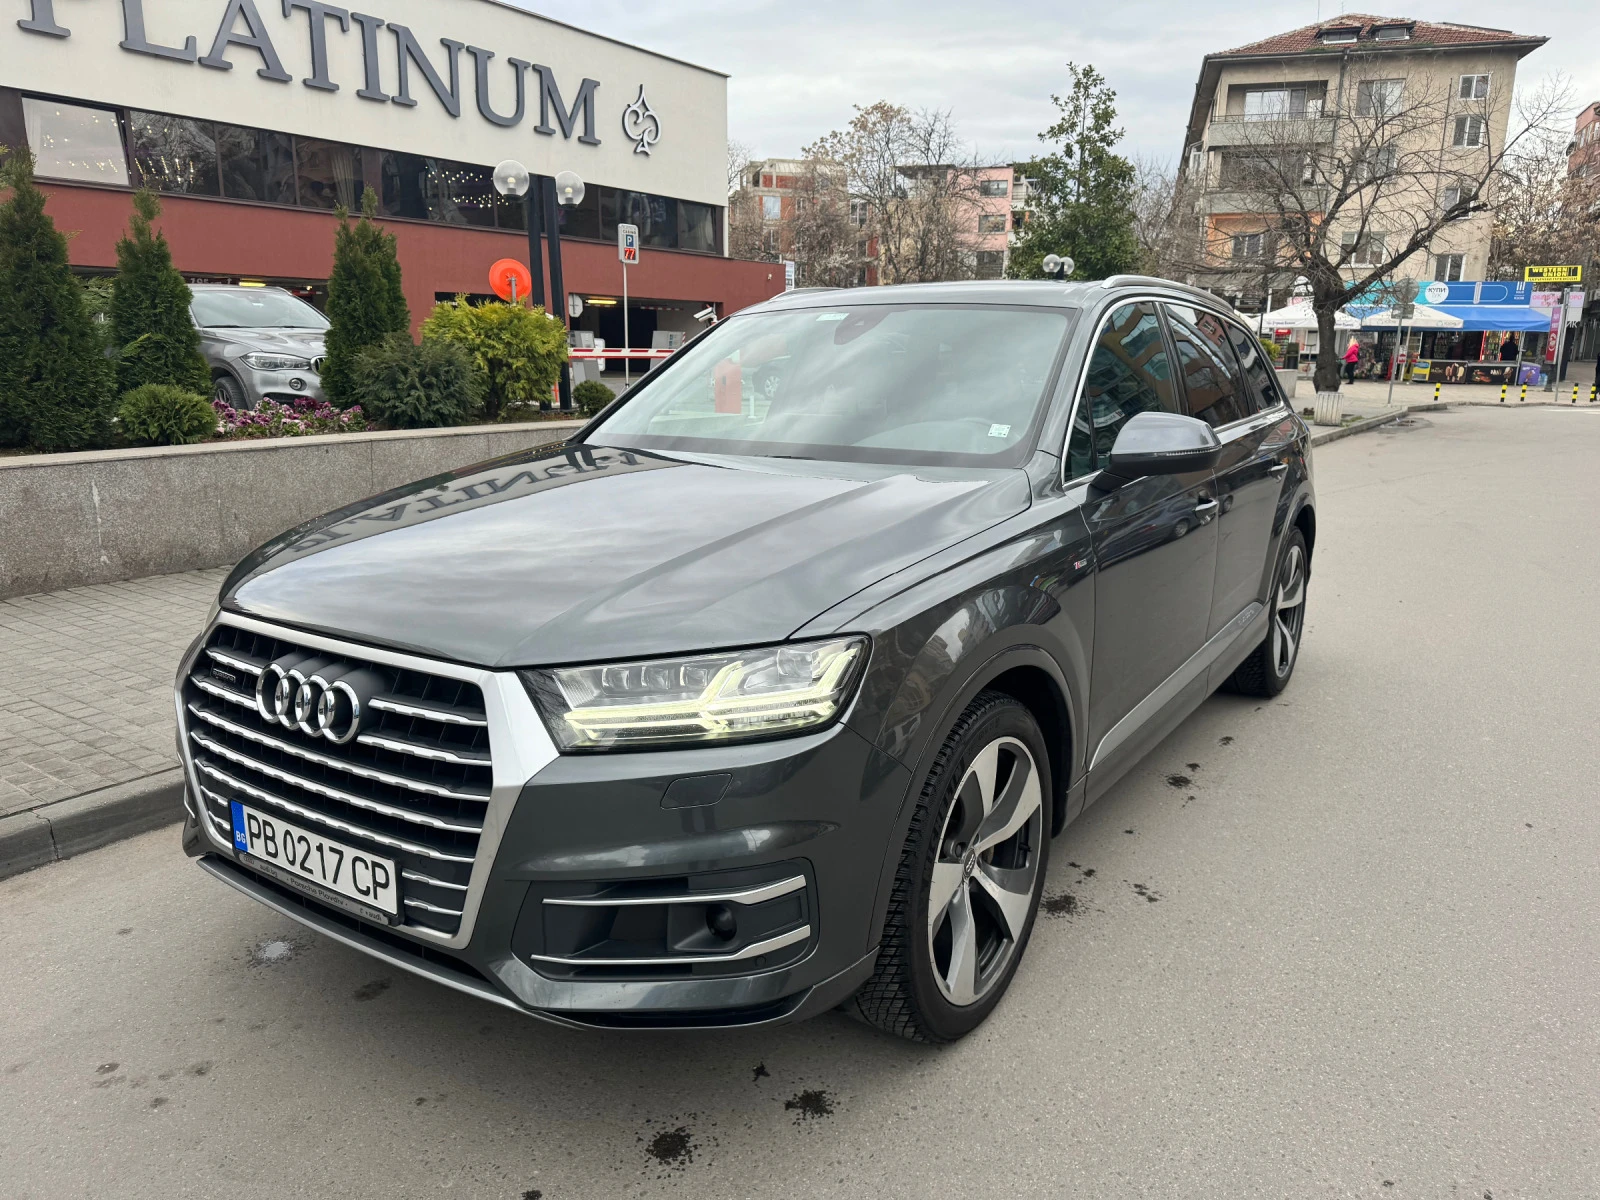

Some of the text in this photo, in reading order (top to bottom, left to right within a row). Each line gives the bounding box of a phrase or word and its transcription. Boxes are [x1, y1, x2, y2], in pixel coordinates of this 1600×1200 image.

[627, 235, 633, 246] P
[624, 248, 636, 260] 77
[236, 830, 246, 844] BG
[246, 812, 390, 901] PB 0217 CP
